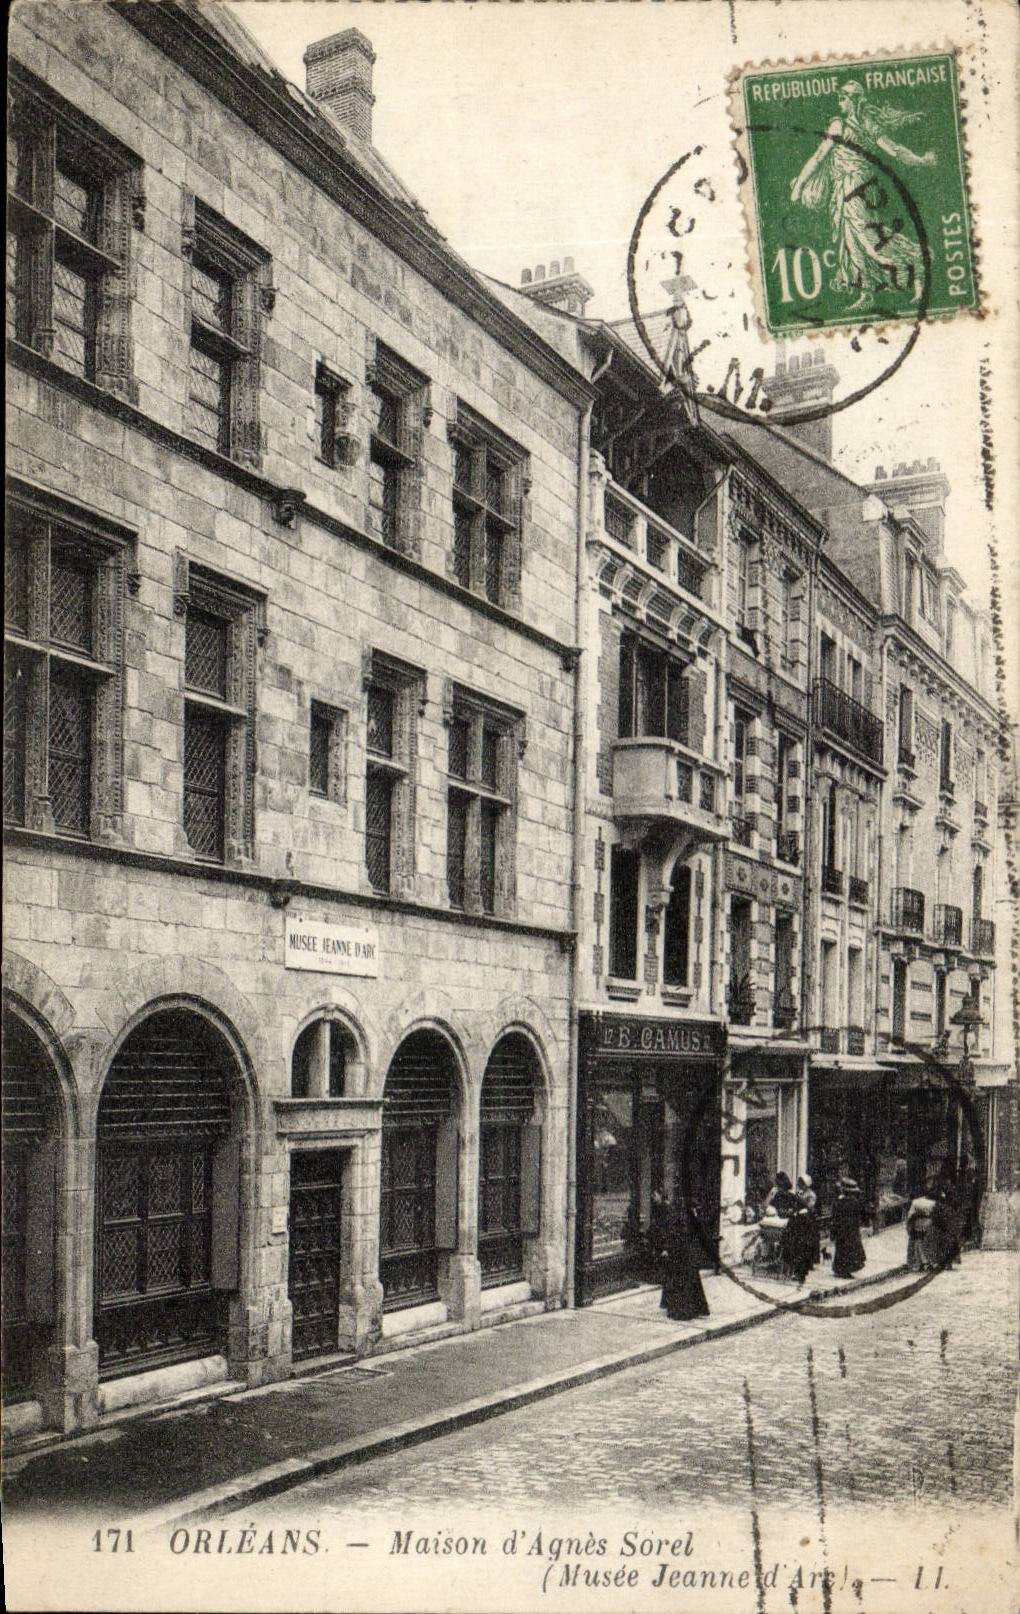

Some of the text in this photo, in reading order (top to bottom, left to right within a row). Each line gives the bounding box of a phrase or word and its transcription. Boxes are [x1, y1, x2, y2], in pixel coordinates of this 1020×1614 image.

[865, 64, 947, 91] FRANÇAISE
[943, 211, 967, 296] POSTES
[322, 937, 352, 957] JEANNE
[641, 1026, 701, 1051] CAMUS
